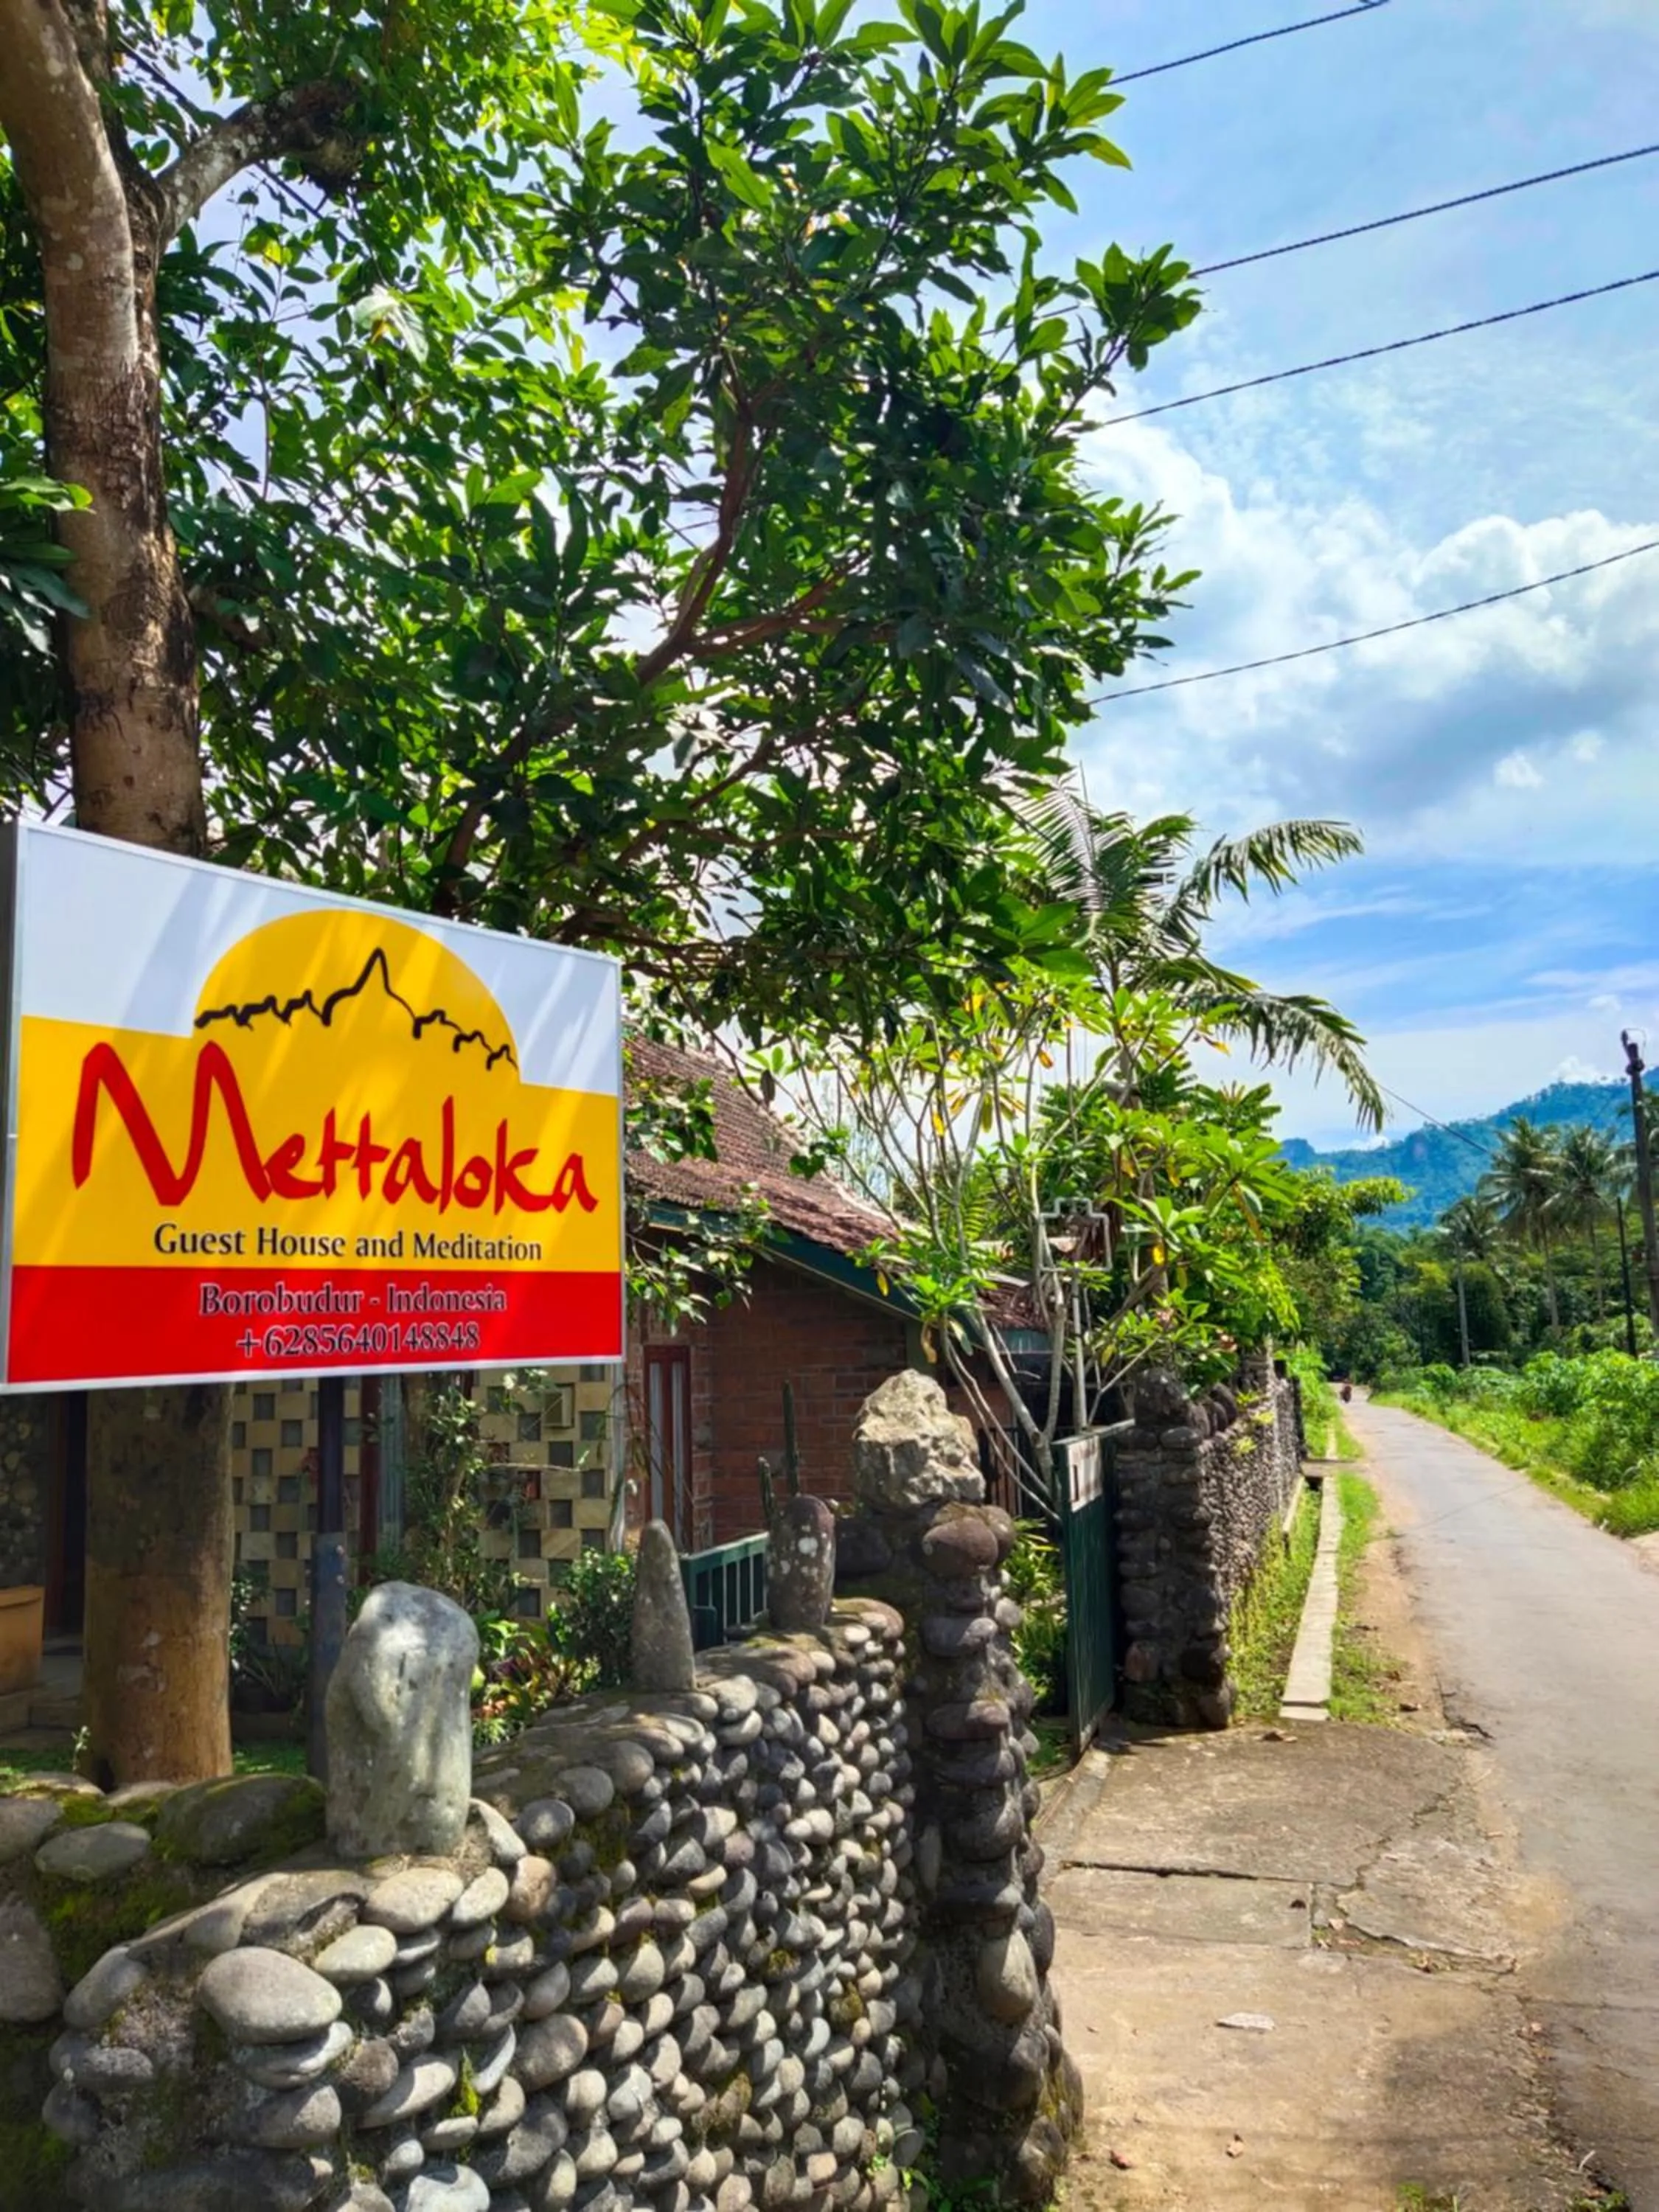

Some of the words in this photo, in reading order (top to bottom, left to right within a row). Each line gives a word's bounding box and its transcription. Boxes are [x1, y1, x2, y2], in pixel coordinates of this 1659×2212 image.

[72, 1040, 599, 1214] Mettaloka
[153, 1222, 246, 1255] Guest
[257, 1226, 346, 1257] House
[355, 1230, 403, 1258] and
[413, 1231, 542, 1261] Meditation
[200, 1281, 365, 1315] Borobudur
[386, 1281, 507, 1314] Indonesia
[235, 1321, 480, 1359] +6285640148848
